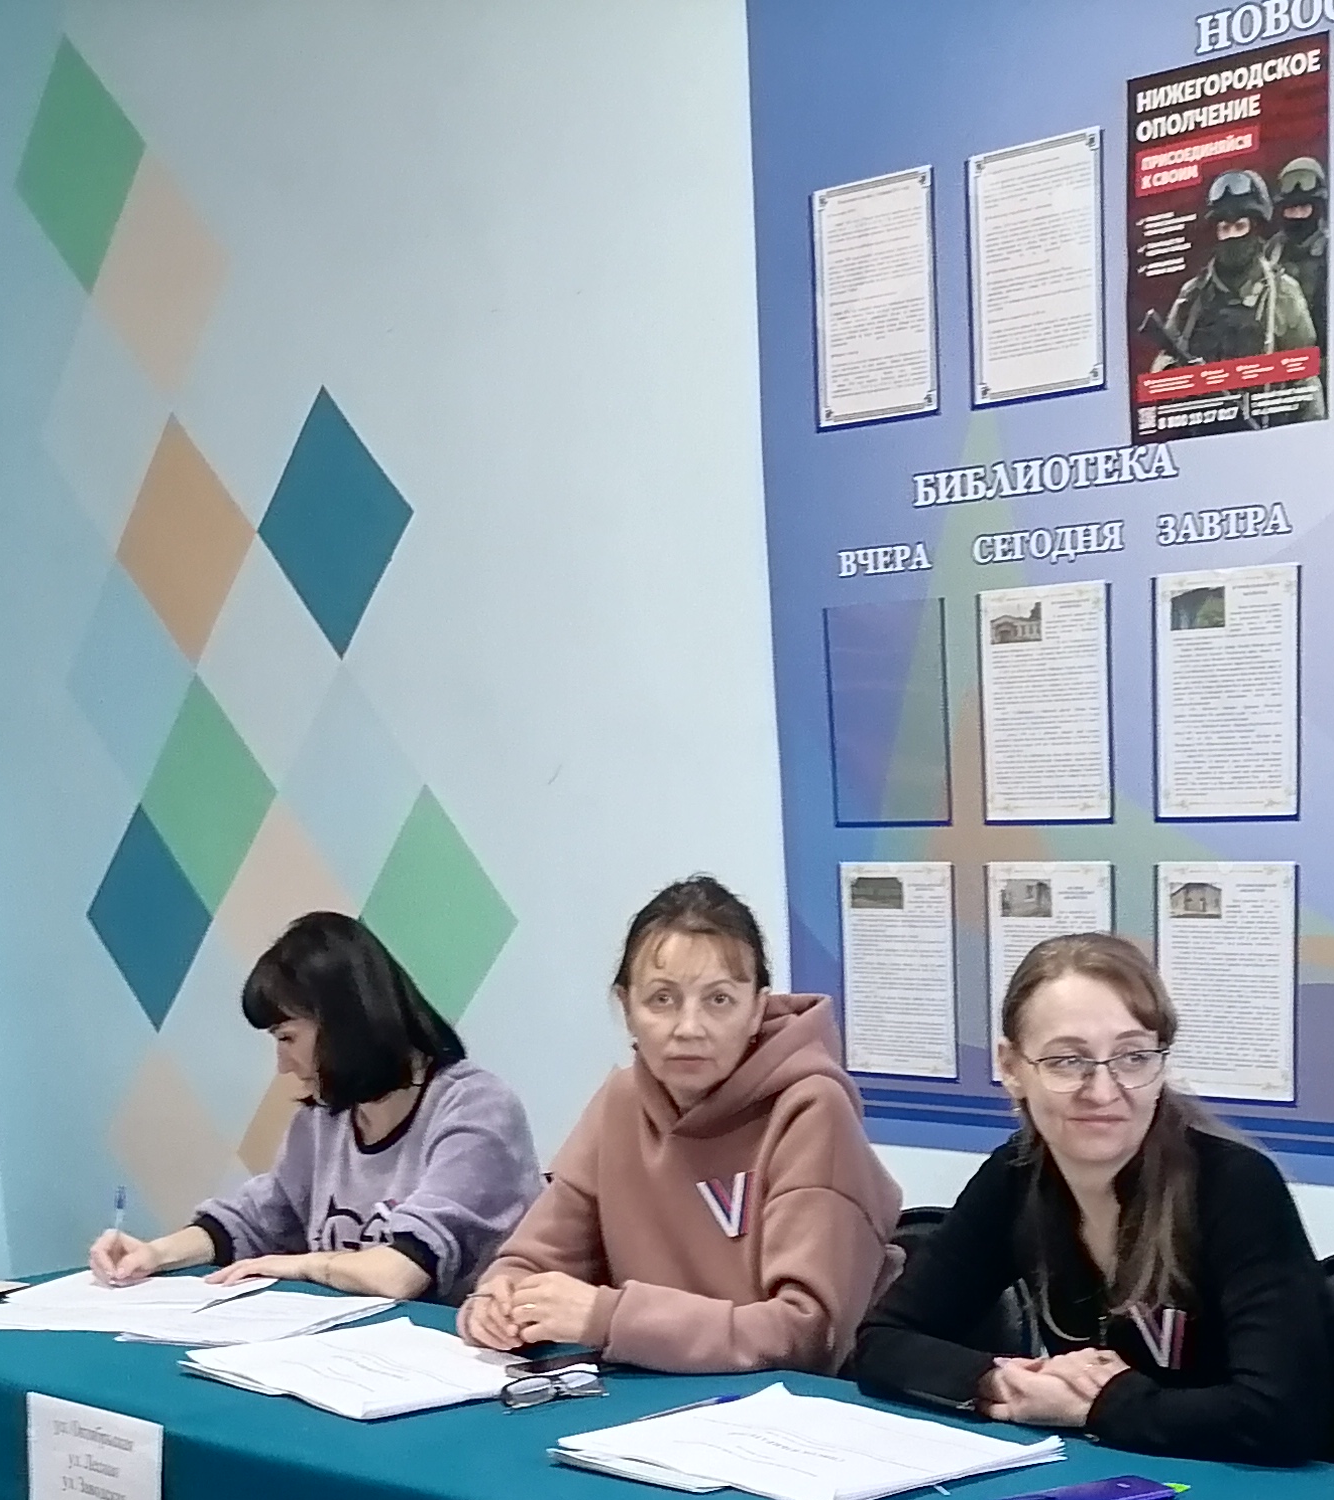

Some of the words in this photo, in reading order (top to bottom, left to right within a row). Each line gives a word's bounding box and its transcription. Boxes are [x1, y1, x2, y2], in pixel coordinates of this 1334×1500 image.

[1135, 48, 1322, 114] НИЖЕГОРОДСКОЕ
[1135, 93, 1262, 143] ОПОЛЧЕНИЕ
[1140, 133, 1253, 172] ПРИСОЕДИНЯЙСЯ
[1140, 174, 1153, 190] К
[1153, 163, 1199, 188] СВОИМ
[912, 443, 1179, 508] БИБЛИОТЕКА
[837, 541, 932, 578] ВЧЕРА
[971, 520, 1125, 564] СЕГОДНЯ
[1156, 503, 1292, 546] ЗАВТРА
